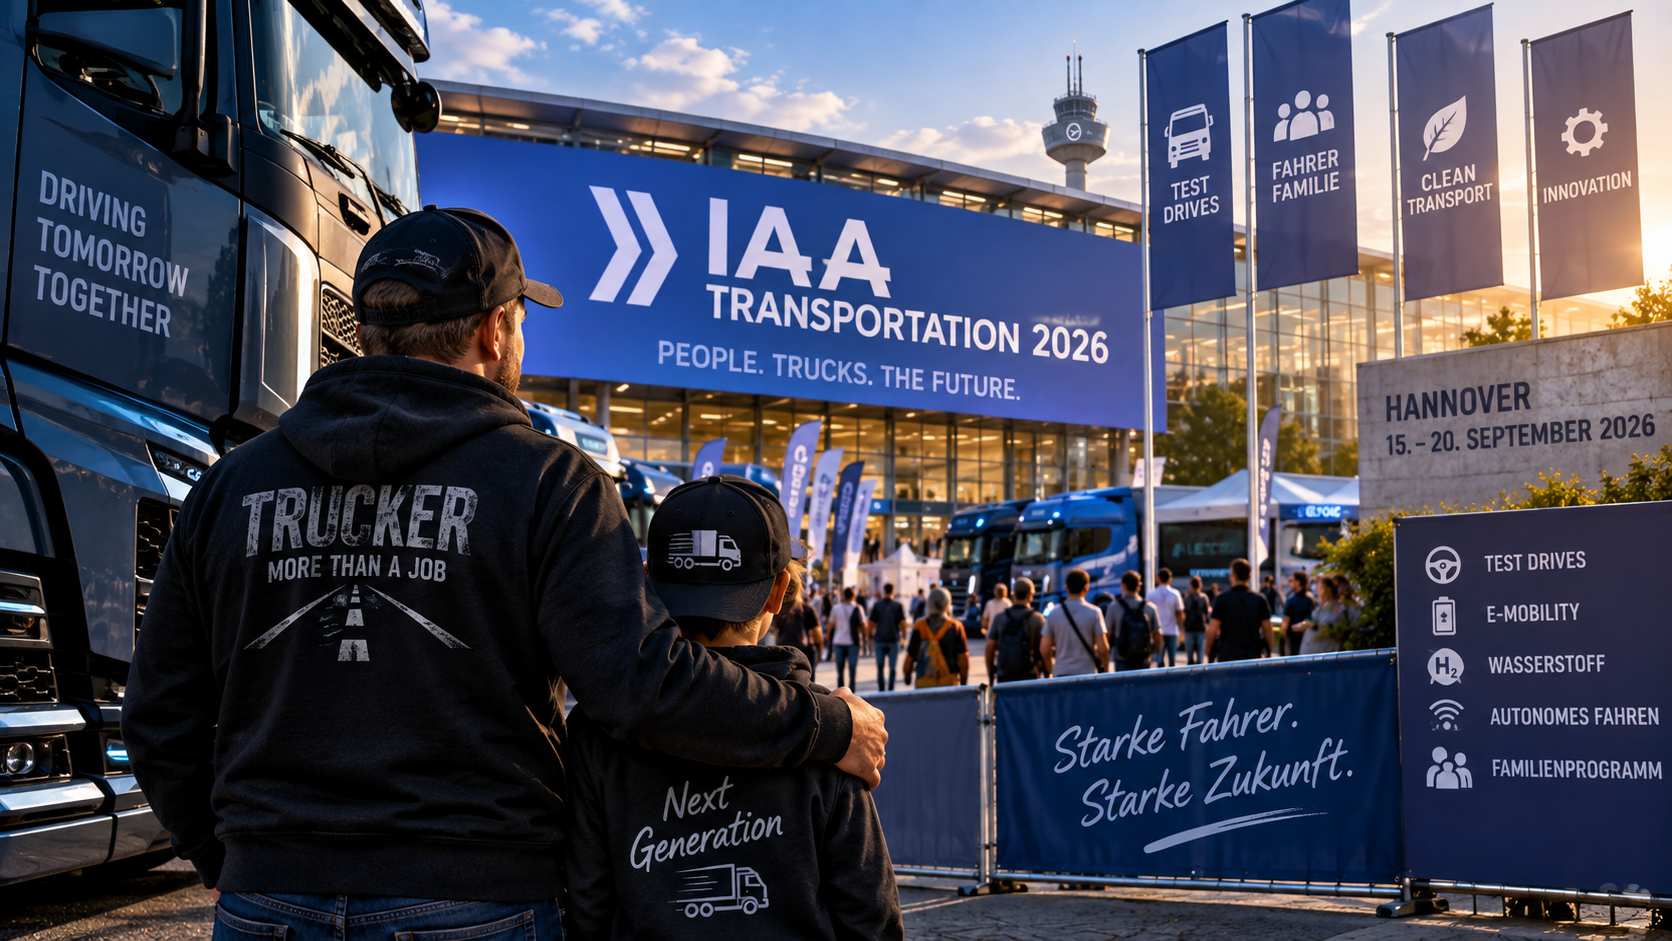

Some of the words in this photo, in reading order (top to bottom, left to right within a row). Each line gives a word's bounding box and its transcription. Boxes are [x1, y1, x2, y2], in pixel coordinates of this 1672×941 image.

[1272, 150, 1339, 180] FAHRER
[1421, 164, 1476, 190] CLEAN
[39, 170, 146, 237] DRIVING
[1171, 175, 1210, 200] TEST
[1272, 172, 1340, 203] FAMILIE
[1407, 183, 1493, 215] TRANSPORT
[1543, 170, 1632, 204] INNOVATION
[1163, 195, 1220, 223] DRIVES
[36, 217, 189, 297] TOMORROW
[708, 198, 891, 298] IAA
[34, 264, 171, 338] TOGETHER
[706, 284, 1020, 353] TRANSPORTATION
[1032, 323, 1109, 363] 2026
[658, 341, 763, 375] PEOPLE.
[773, 354, 872, 385] TRUCKS.
[881, 365, 924, 392] THE
[932, 371, 1021, 401] FUTURE.
[1386, 382, 1531, 422] HANNOVER
[1467, 419, 1591, 450] SEPTEMBER
[1600, 414, 1655, 440] 2026
[241, 484, 478, 557] TRUCKER
[268, 555, 321, 583] MORE
[330, 555, 381, 577] THAN
[388, 557, 401, 578] A
[408, 559, 446, 583] JOB
[1485, 554, 1522, 572] TEST
[1528, 551, 1586, 570] DRIVES
[1487, 603, 1580, 623] E-MOBILITY
[1488, 655, 1605, 674] WASSERSTOFF
[1490, 707, 1589, 726] AUTONOMES
[1595, 707, 1659, 726] FAHREN
[1054, 714, 1166, 774] Starke
[1179, 698, 1298, 751] Fahrer.
[1081, 769, 1193, 827] Starke
[1204, 737, 1353, 805] Zukunft.
[1492, 759, 1663, 779] FAMILIENPROGRAMM
[663, 776, 734, 822] Next
[630, 811, 783, 872] Generation
